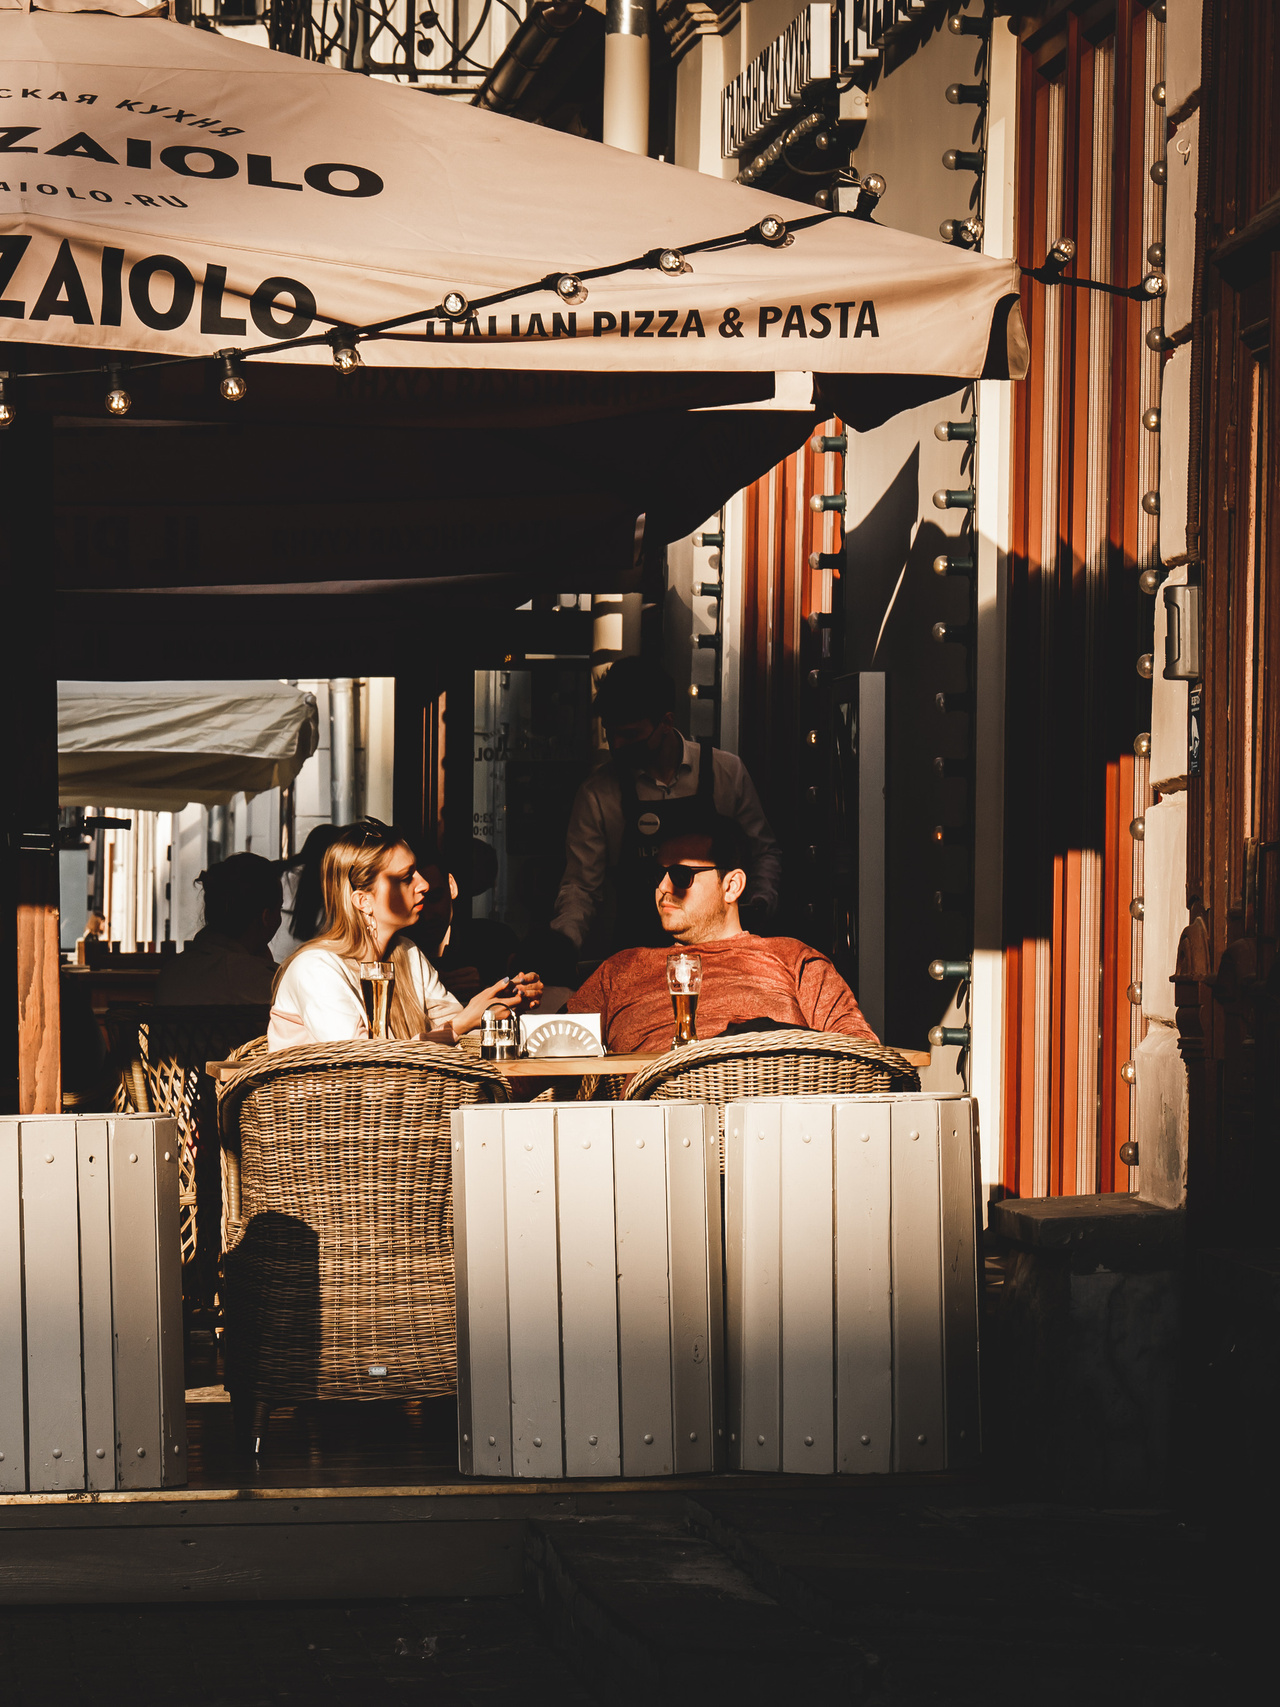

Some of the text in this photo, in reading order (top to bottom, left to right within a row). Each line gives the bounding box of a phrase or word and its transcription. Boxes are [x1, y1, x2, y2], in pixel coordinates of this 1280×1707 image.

[114, 99, 245, 138] КУХНЯ
[592, 308, 706, 338] PIZZA
[717, 307, 745, 339] &
[758, 300, 880, 339] PASTA
